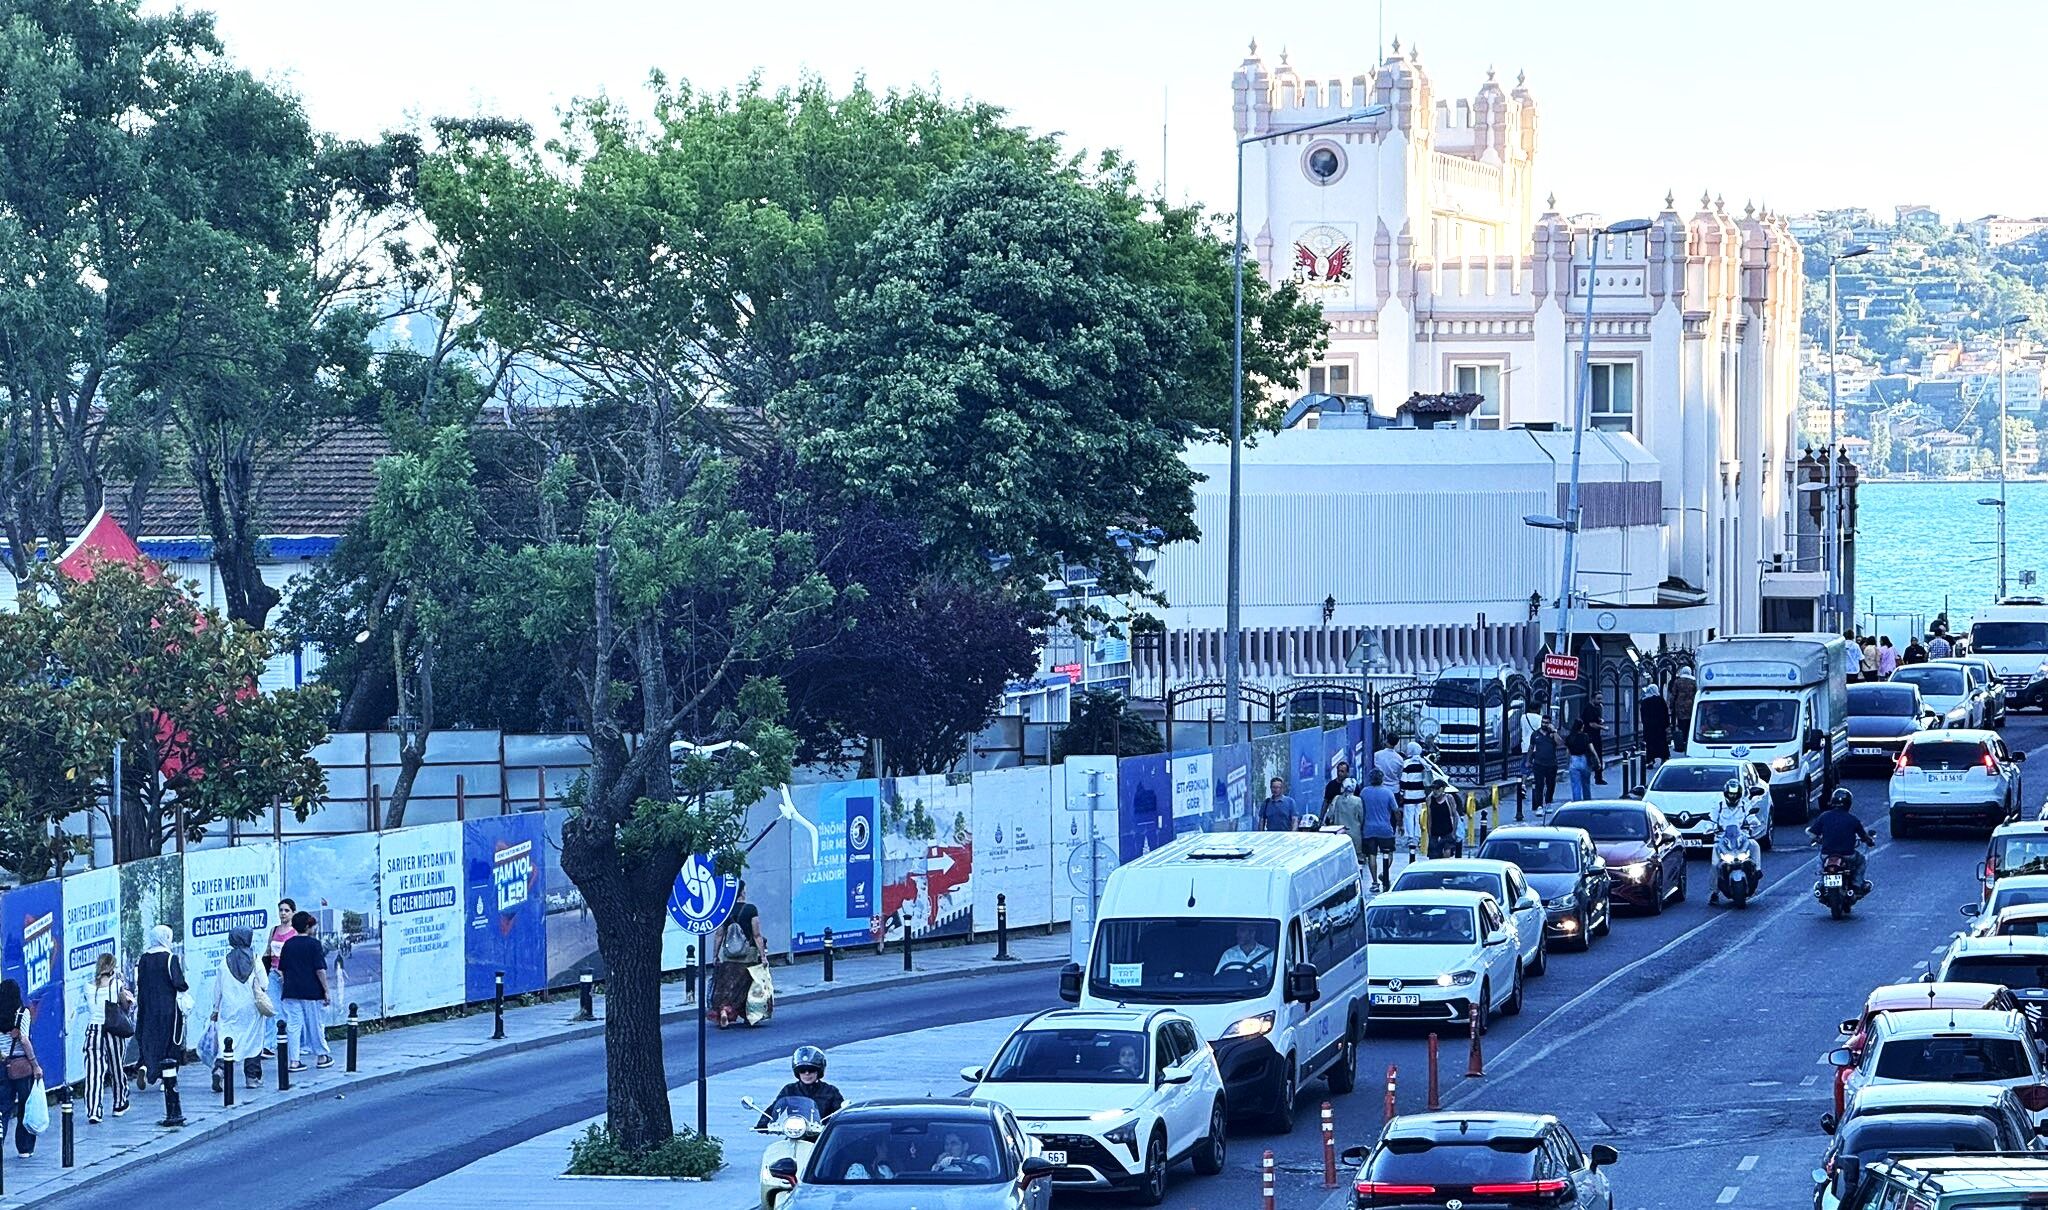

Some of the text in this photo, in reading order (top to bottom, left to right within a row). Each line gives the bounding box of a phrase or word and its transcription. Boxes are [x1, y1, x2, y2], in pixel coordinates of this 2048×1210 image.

[1546, 657, 1577, 669] ASKERİ ARAÇ
[1546, 667, 1575, 677] ÇIKABİLİR
[821, 838, 834, 850] BİR
[387, 856, 416, 873] SARIYER
[191, 873, 269, 896] SARIYER MEYDANI'NI
[400, 870, 446, 889] VE KIYILARINI
[497, 873, 528, 911] İLERİ
[204, 893, 256, 912] VE KIYILARINI
[391, 890, 454, 914] GÜÇLENDİRİYORUZ
[194, 913, 265, 937] GÜÇLENDİRİYORUZ
[686, 919, 714, 933] 1940
[1118, 970, 1135, 978] TRT
[1375, 995, 1418, 1004] 34 PFO 173
[1048, 1152, 1065, 1163] 663
